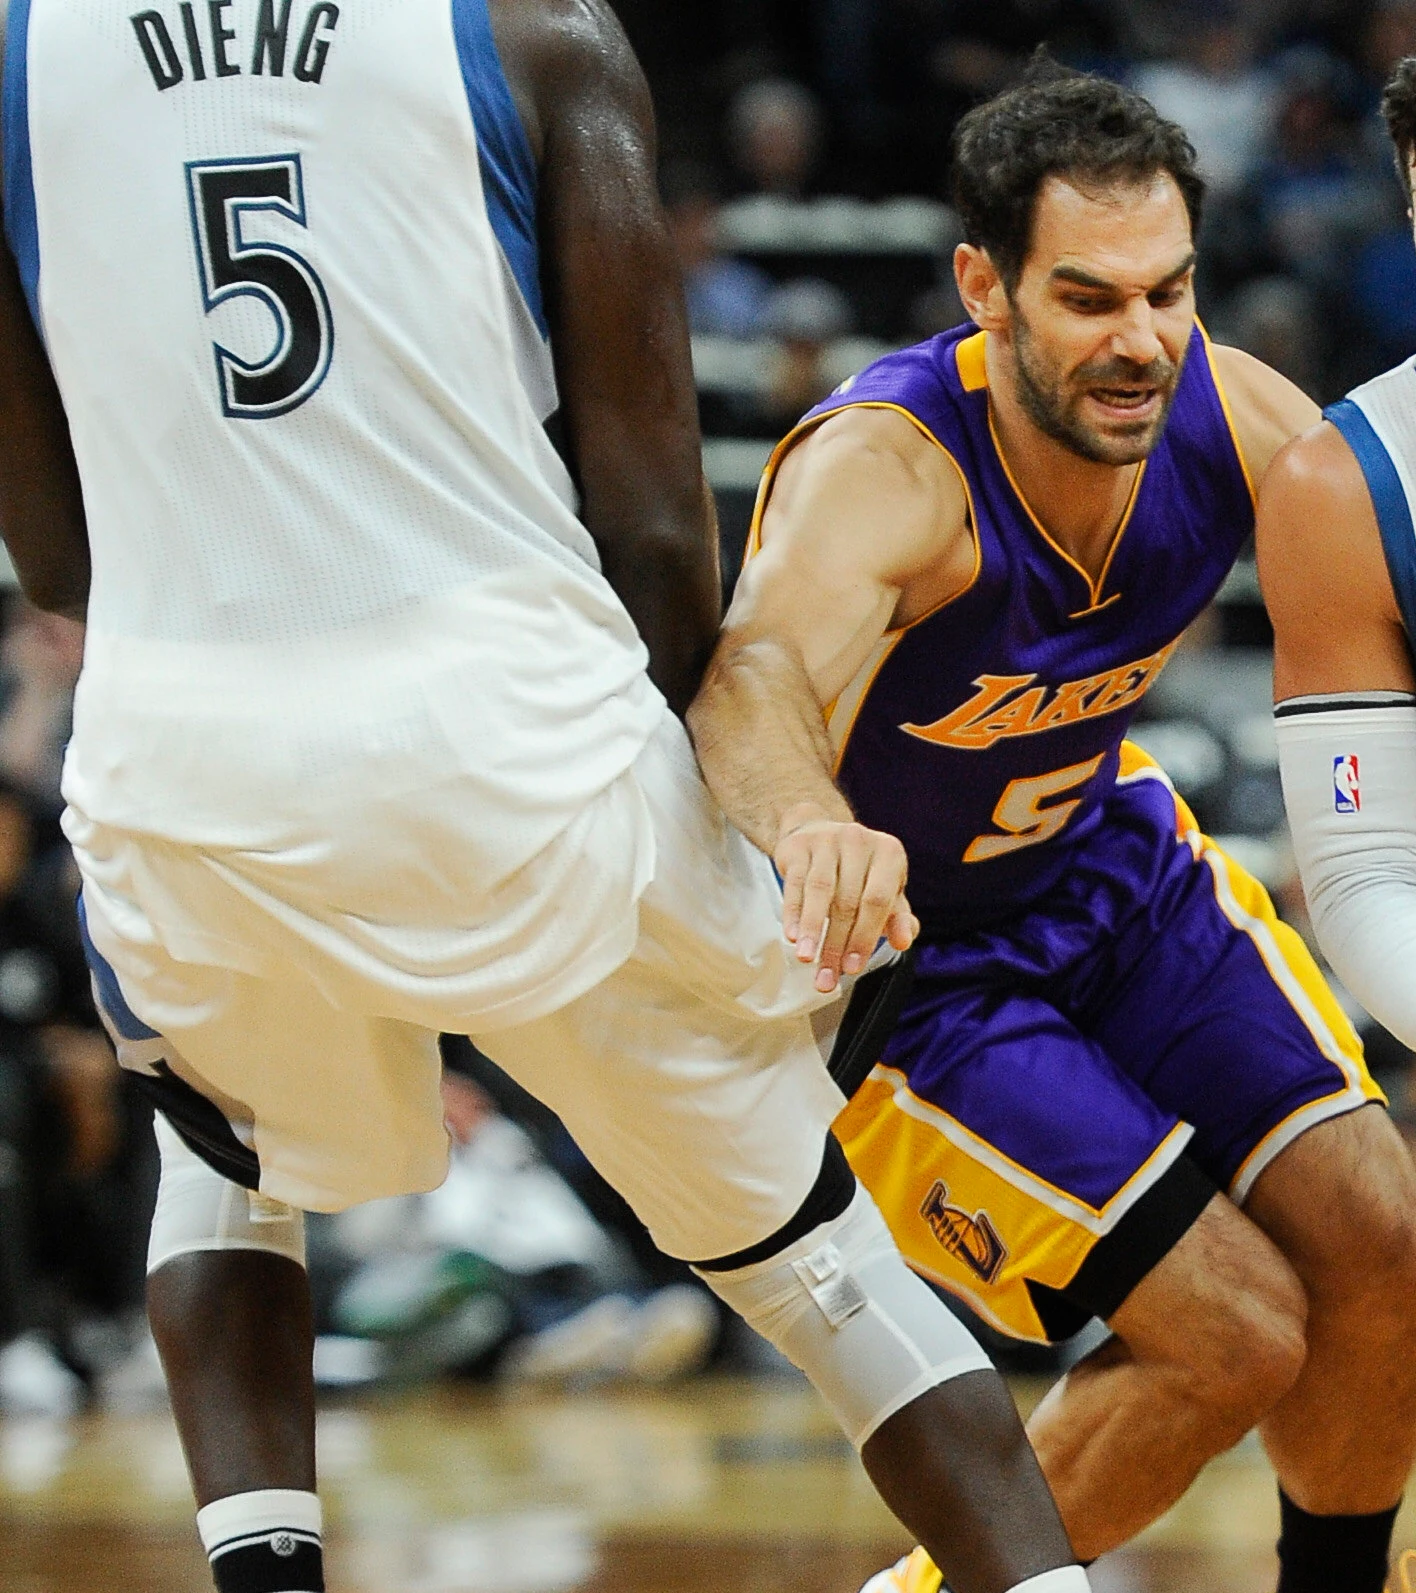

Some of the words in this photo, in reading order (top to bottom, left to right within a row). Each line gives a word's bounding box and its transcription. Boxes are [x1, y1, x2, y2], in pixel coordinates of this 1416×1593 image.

[129, 0, 340, 92] DIENG
[183, 152, 335, 420] 5
[962, 750, 1107, 863] 5
